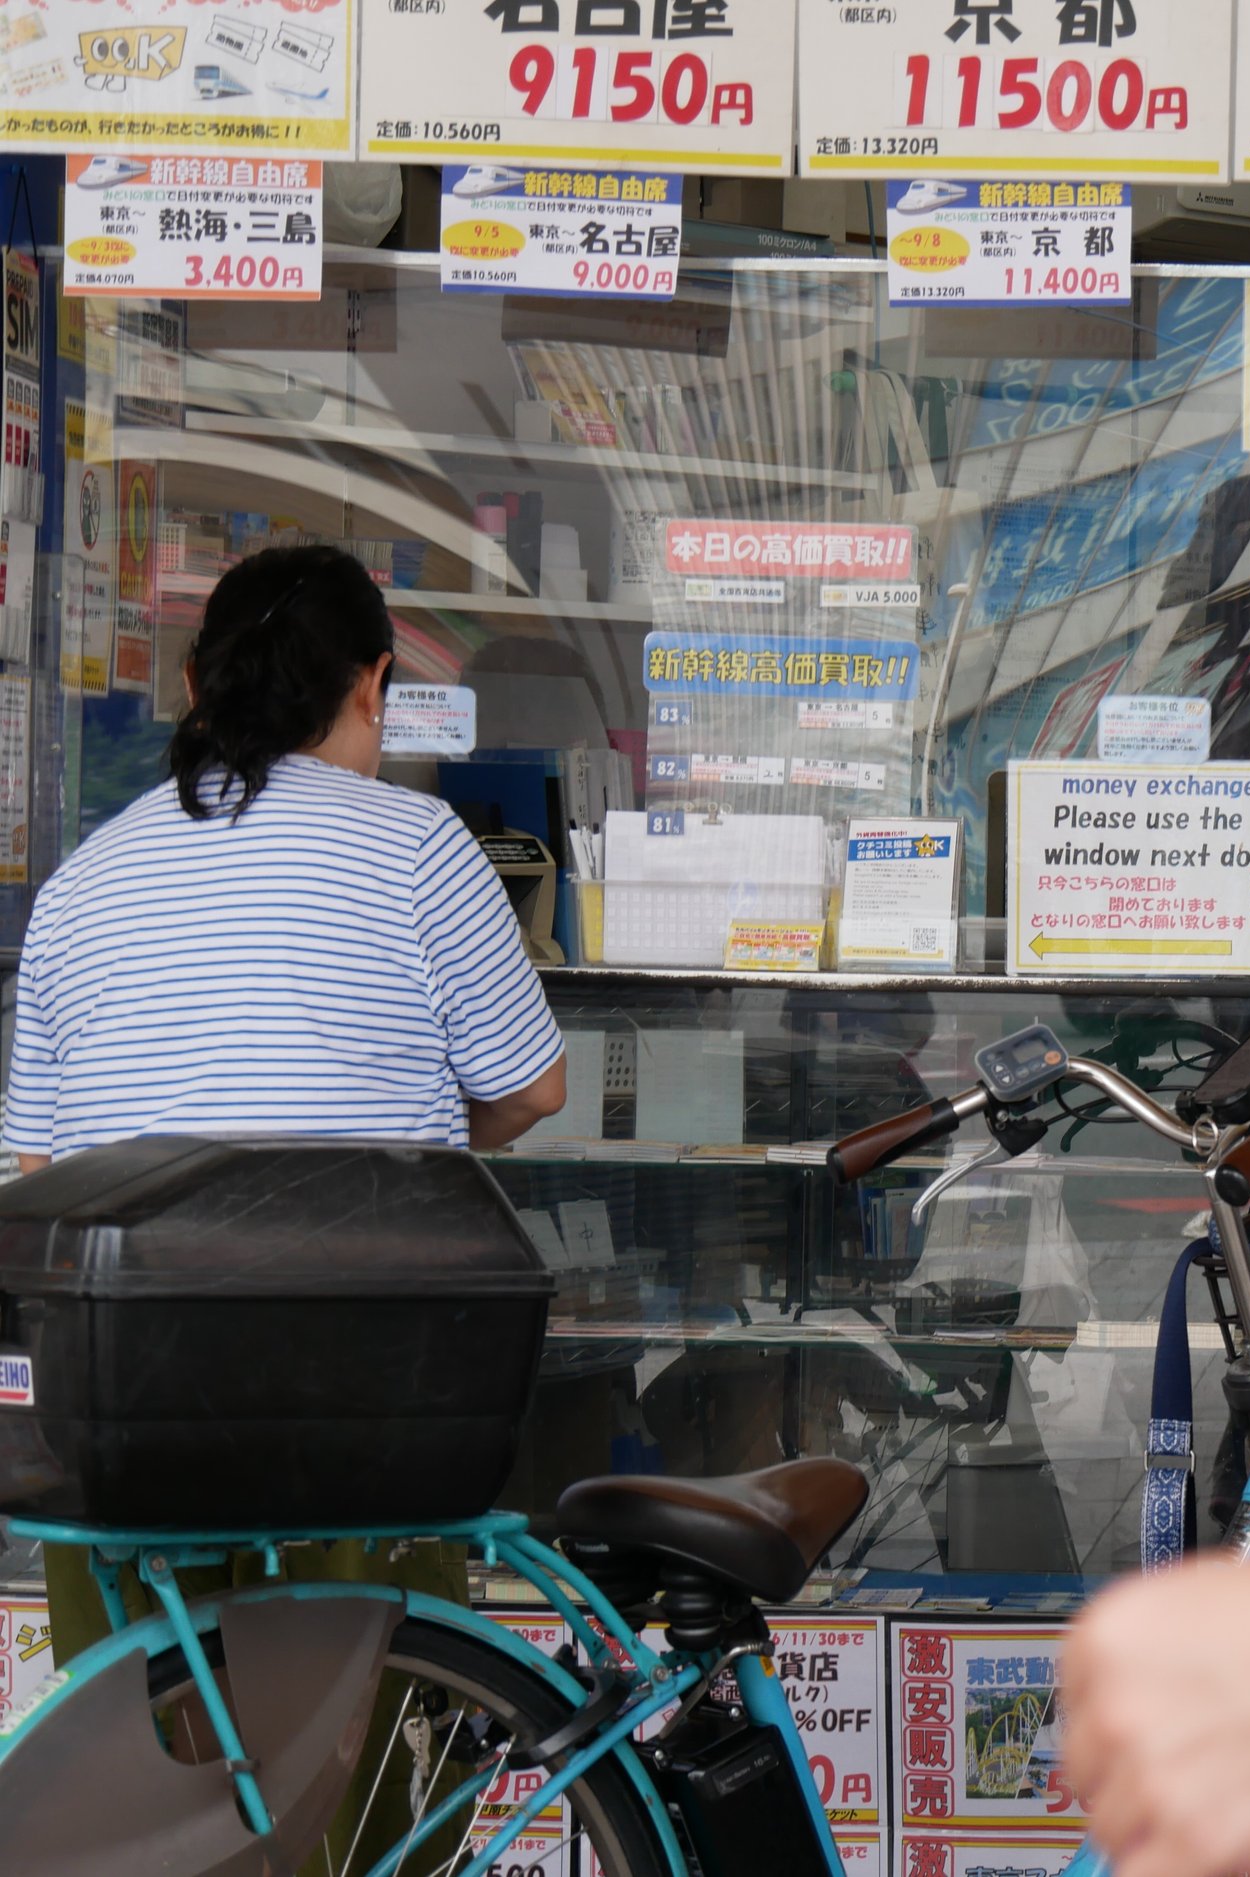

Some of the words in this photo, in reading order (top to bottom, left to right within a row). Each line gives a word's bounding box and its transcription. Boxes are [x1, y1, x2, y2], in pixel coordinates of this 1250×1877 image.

[839, 8, 897, 24] (都区内)
[509, 44, 753, 126] 9150円
[906, 54, 1188, 132] 11500円
[150, 157, 308, 188] 新幹線自由席
[524, 171, 669, 203] 新幹線自由席
[979, 182, 1123, 208] 新幹線自由席
[101, 225, 139, 236] (都区内)
[158, 208, 316, 245] 熱海・三島
[579, 220, 680, 258] 名古屋
[541, 243, 579, 255] (都区内)
[980, 247, 1017, 258] (都区内)
[1031, 226, 1114, 258] 京都
[184, 255, 304, 288] 3,400円
[572, 260, 673, 292] 9,000円
[1005, 267, 1120, 295] 11,400円
[7, 294, 39, 361] SIM
[671, 531, 908, 567] 本日の高価買取!!
[855, 591, 879, 603] VJA
[649, 647, 909, 688] 新幹線高価買取!!
[398, 690, 448, 700] お客様各位
[1062, 777, 1137, 798] money
[1053, 804, 1136, 829] Please
[1146, 811, 1190, 829] use
[1200, 806, 1243, 831] the
[856, 839, 912, 851] クチコミ投稿
[856, 849, 912, 860] お願いします
[1044, 841, 1141, 867] window
[1151, 843, 1211, 868] next
[1037, 876, 1177, 892] 只今こちらの窓口は
[1108, 896, 1218, 913] 閉めております
[1030, 913, 1246, 931] となりの窓口へお願い致します
[966, 1656, 1066, 1686] 東武動
[795, 1709, 872, 1733] %OFF
[907, 1634, 948, 1816] 激安販売
[836, 1845, 868, 1860] まで
